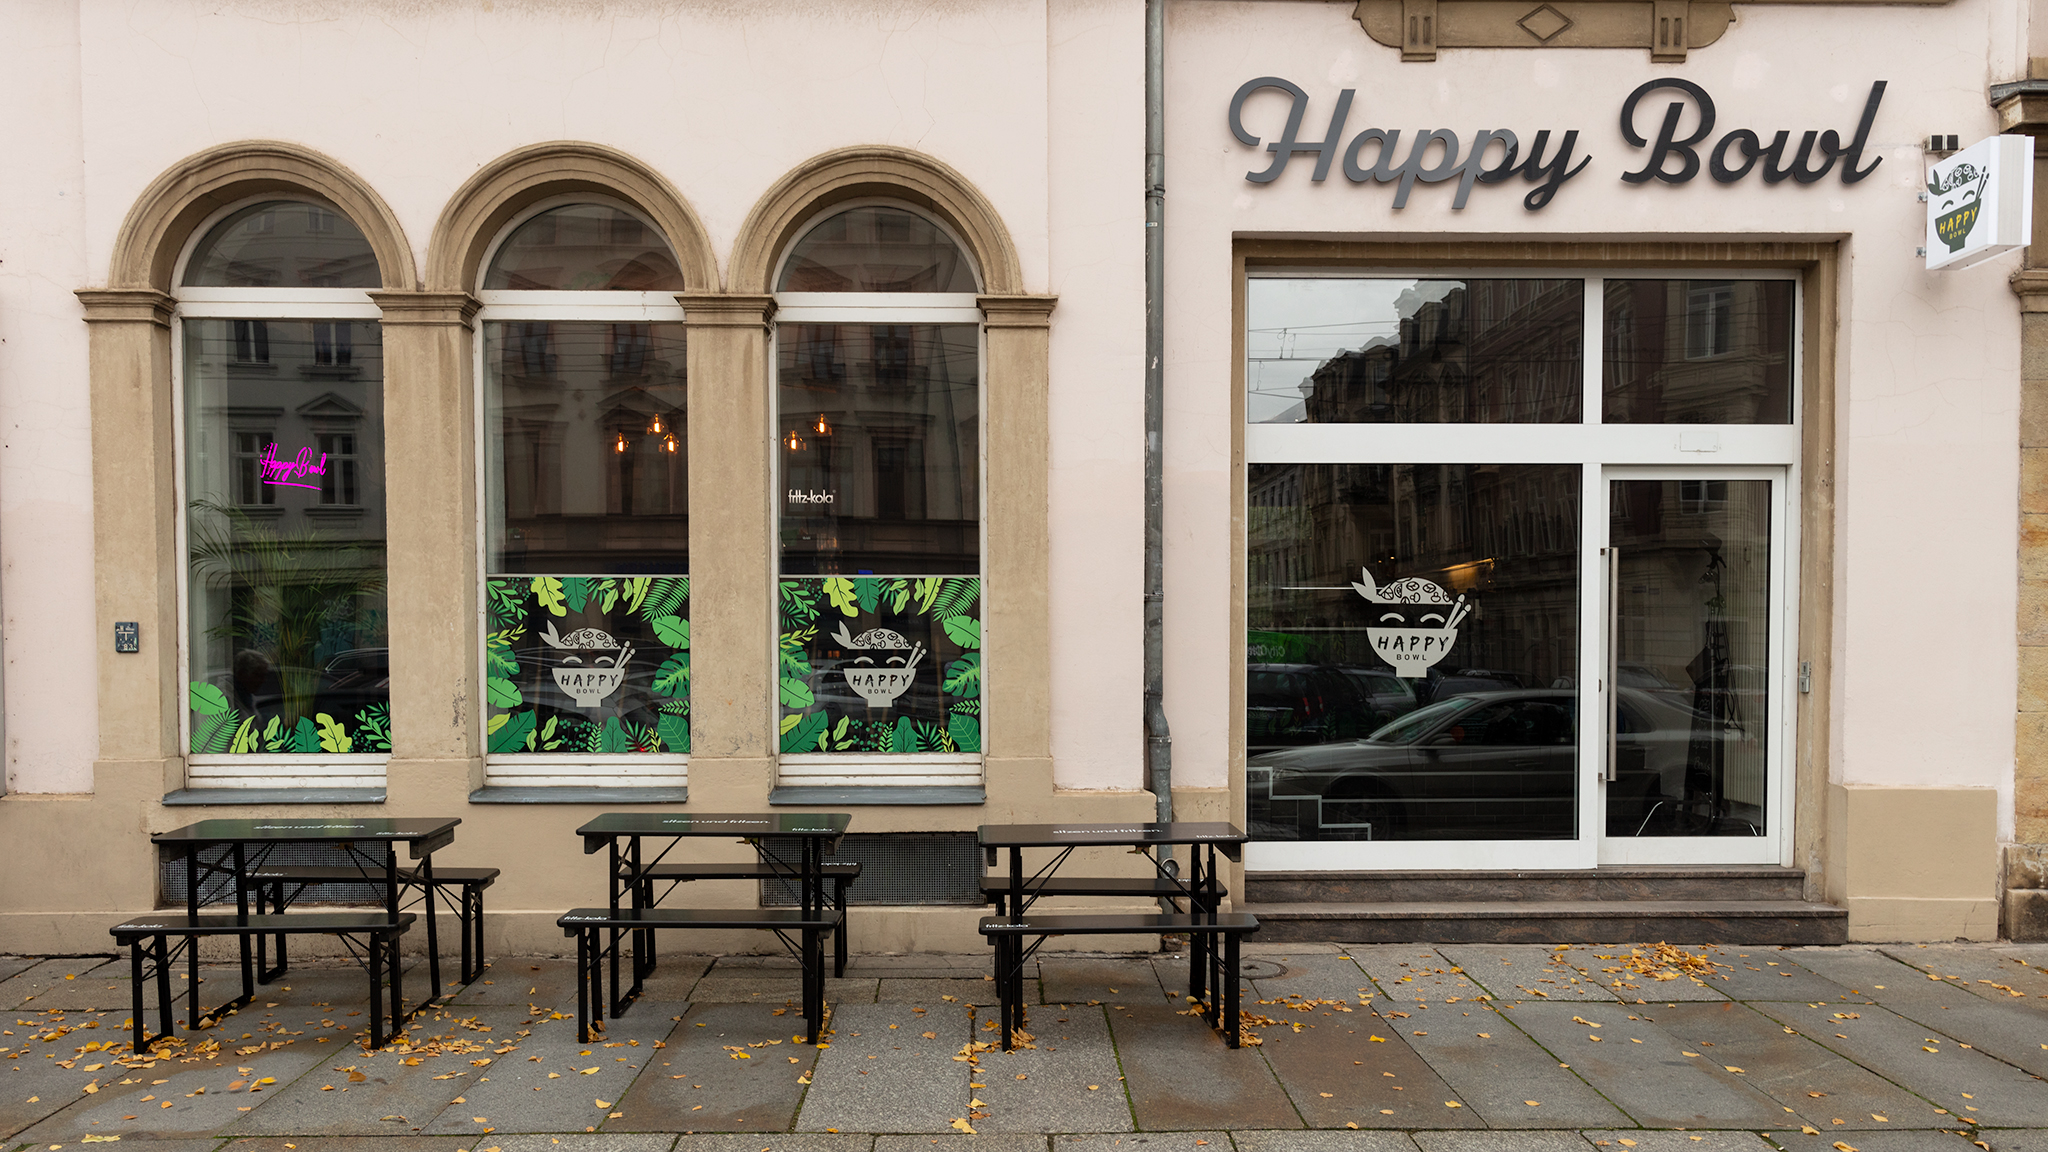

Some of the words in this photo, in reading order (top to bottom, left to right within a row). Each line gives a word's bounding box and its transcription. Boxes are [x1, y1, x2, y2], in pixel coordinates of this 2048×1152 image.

[1228, 76, 1592, 212] Happy
[1620, 77, 1888, 184] Bowl
[1939, 206, 1978, 235] HAPPY
[1949, 228, 1966, 240] BOWL
[259, 442, 297, 482] Happy
[294, 446, 327, 479] Bowl
[788, 489, 834, 504] fritz-kola
[1377, 635, 1450, 652] HAPPY
[561, 673, 619, 688] HAPPY
[852, 673, 910, 688] HAPPY
